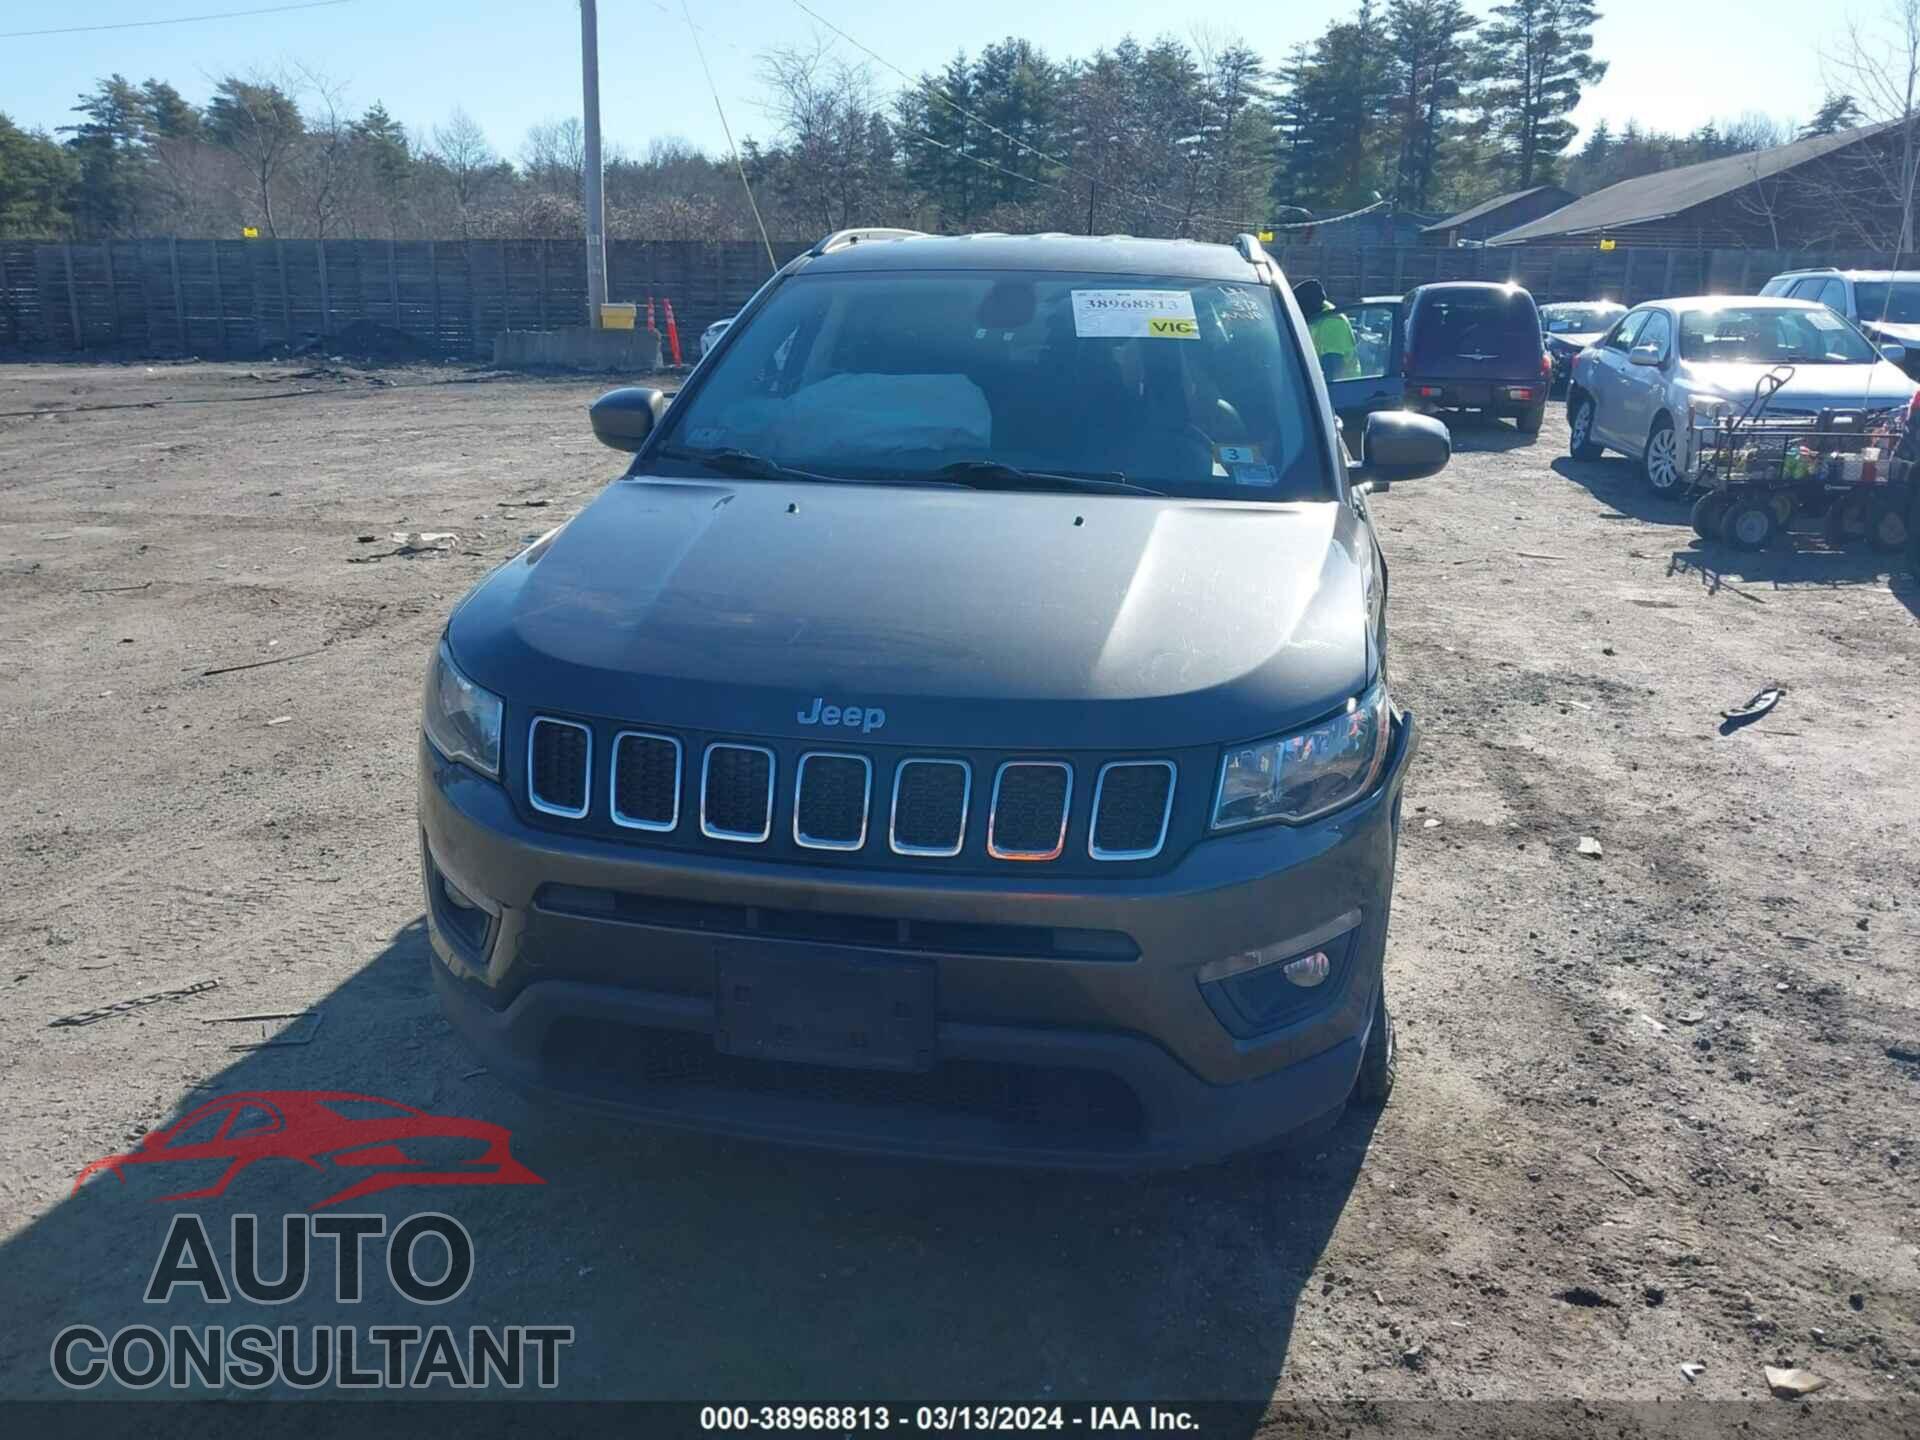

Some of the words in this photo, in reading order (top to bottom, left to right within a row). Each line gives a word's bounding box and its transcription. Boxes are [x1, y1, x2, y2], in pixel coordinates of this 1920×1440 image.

[1084, 299, 1179, 310] 38968813
[1227, 448, 1240, 460] 3
[797, 697, 886, 734] Jeep
